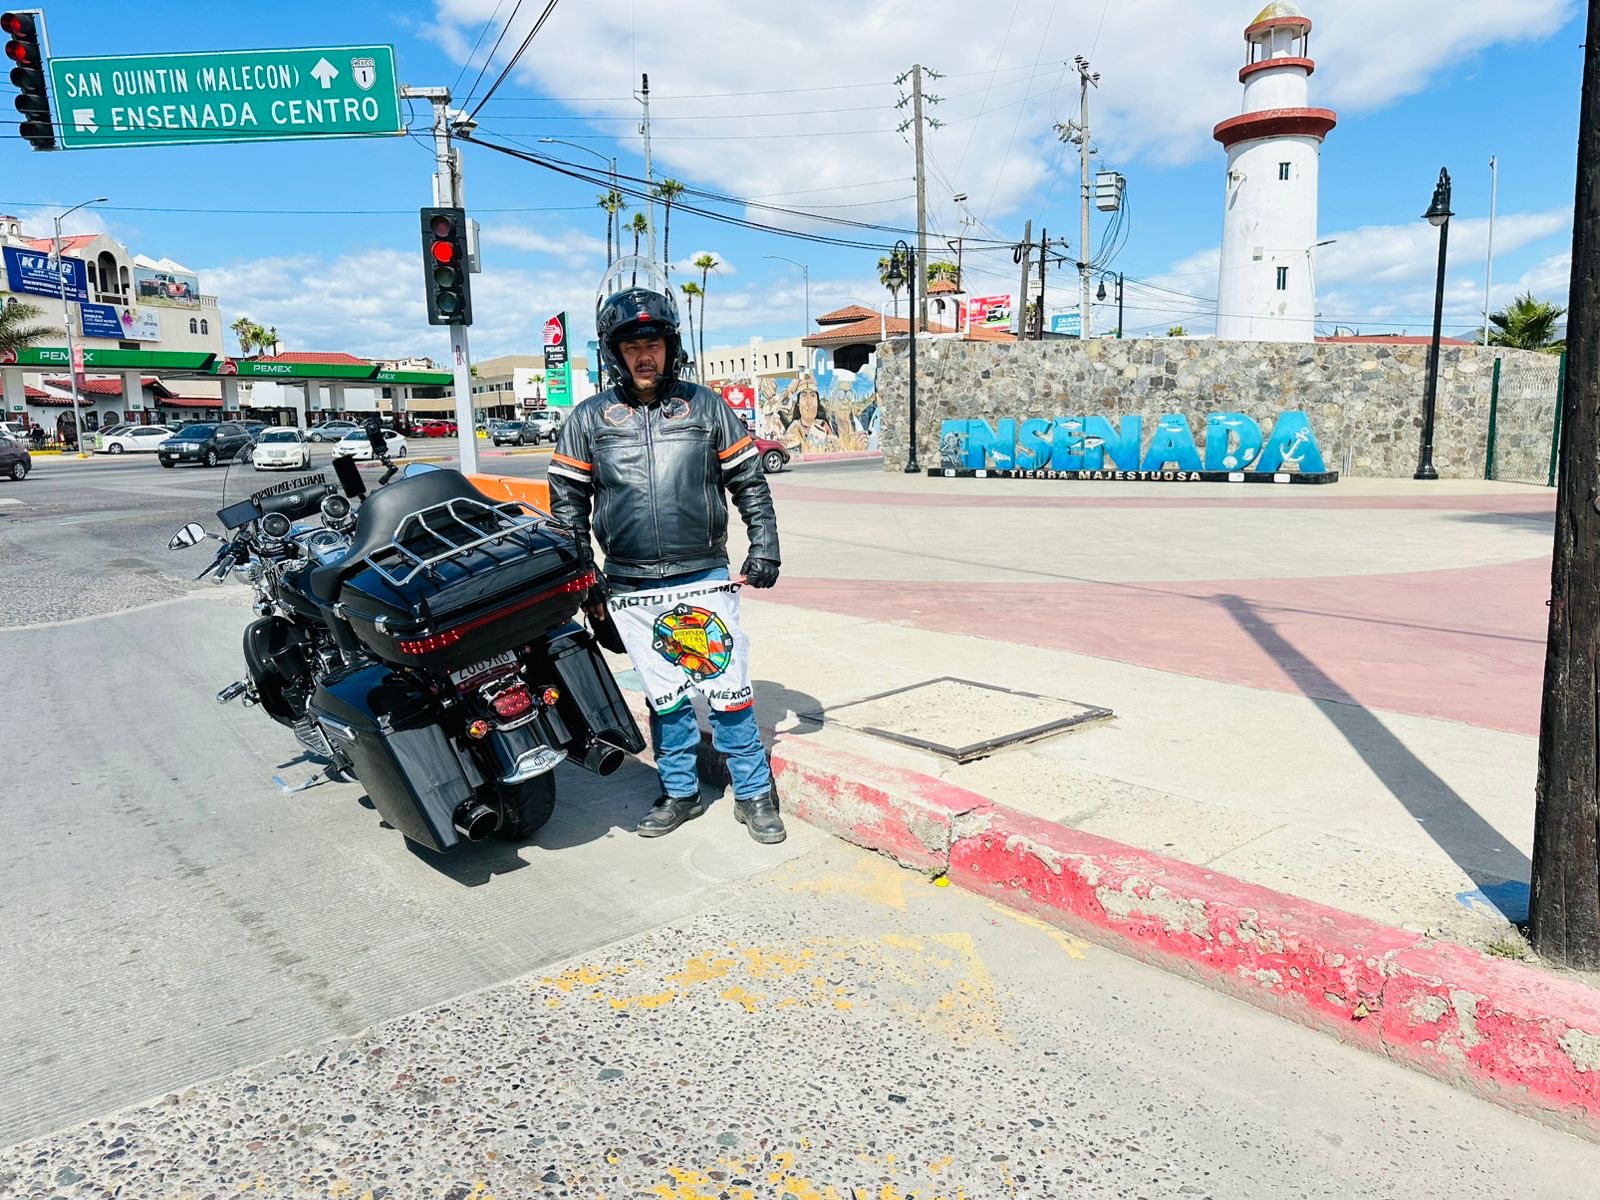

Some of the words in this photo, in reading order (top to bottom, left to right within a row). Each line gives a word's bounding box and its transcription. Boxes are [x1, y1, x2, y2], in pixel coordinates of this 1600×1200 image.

[65, 72, 103, 97] SAN
[112, 69, 188, 96] QUINTIN
[196, 64, 300, 92] (MALECON)
[361, 70, 367, 82] 1
[111, 102, 259, 131] ENSENADA
[271, 96, 379, 125] CENTRO
[21, 256, 73, 274] KING
[40, 351, 94, 361] PEMX
[253, 364, 292, 373] PEMEX
[940, 411, 1327, 472] ENSENADA
[1009, 469, 1068, 480] TIERRA
[1078, 470, 1202, 482] MAJESTUOSA
[610, 583, 742, 613] MOTOTURISMO
[677, 606, 688, 614] N
[655, 692, 673, 706] EN
[709, 685, 752, 700] MÉXICO
